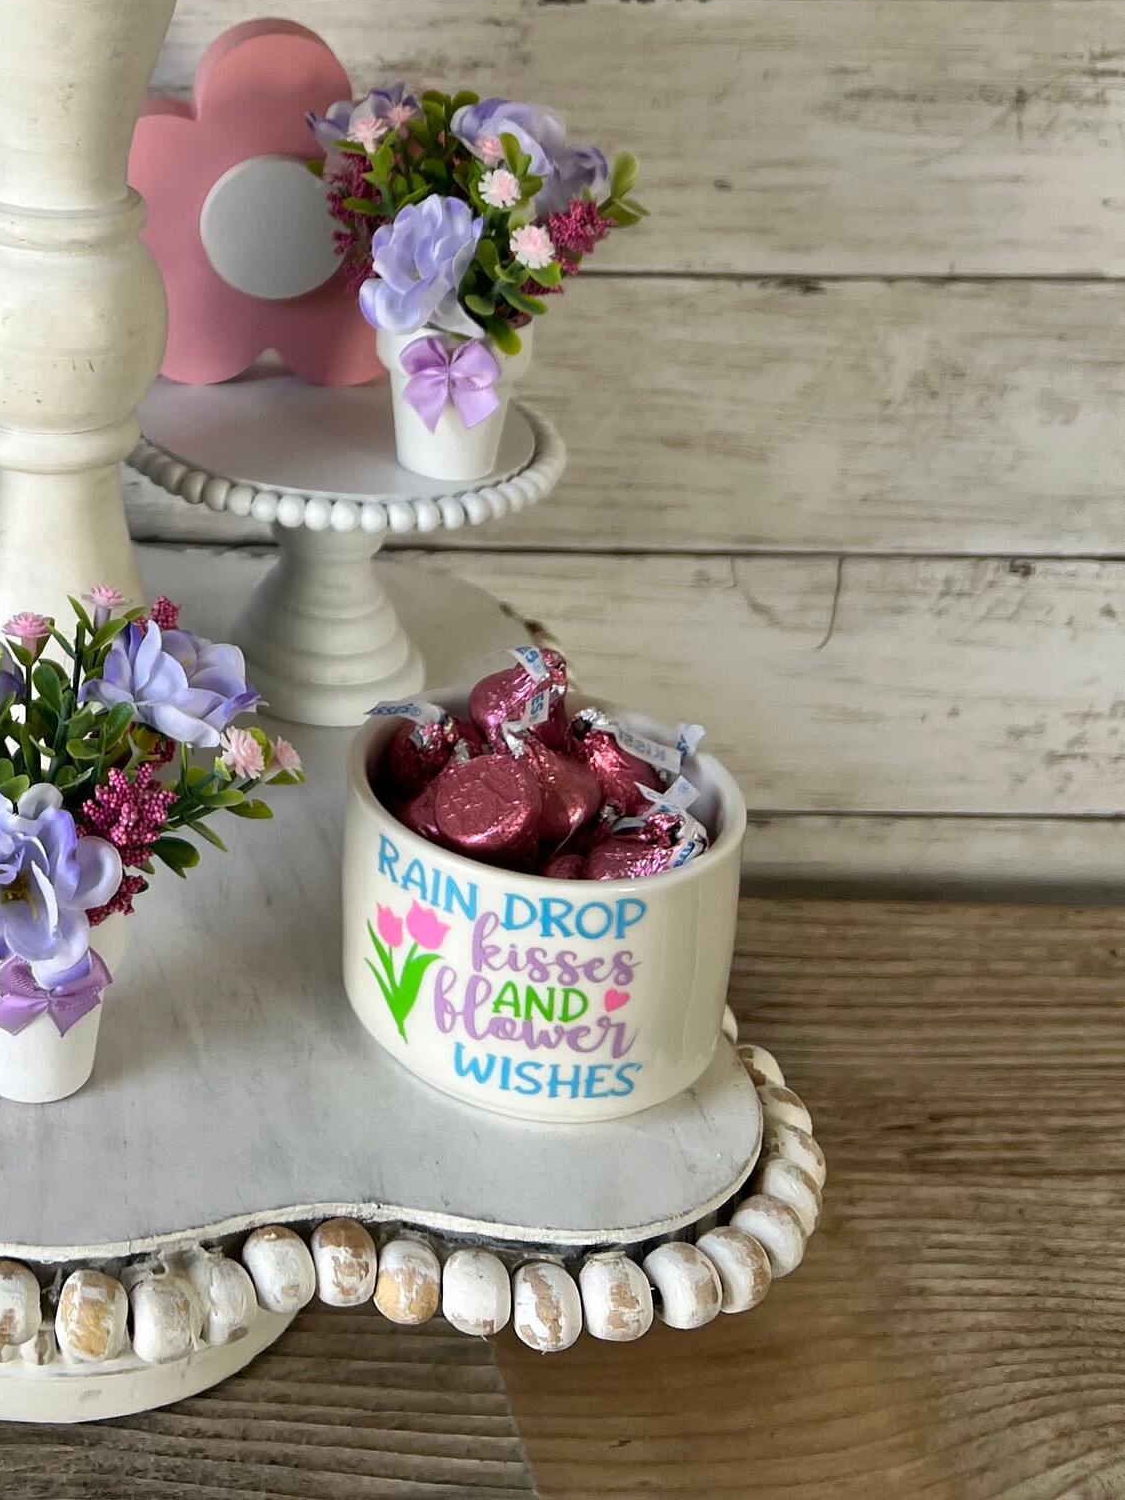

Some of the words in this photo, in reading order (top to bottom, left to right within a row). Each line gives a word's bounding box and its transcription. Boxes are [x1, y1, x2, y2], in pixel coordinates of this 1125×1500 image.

[378, 833, 478, 922] RAIN
[500, 892, 647, 941] DROP
[472, 912, 642, 987] kisses
[433, 965, 638, 1060] flower
[492, 980, 590, 1024] AND
[453, 1041, 643, 1100] WISHES
